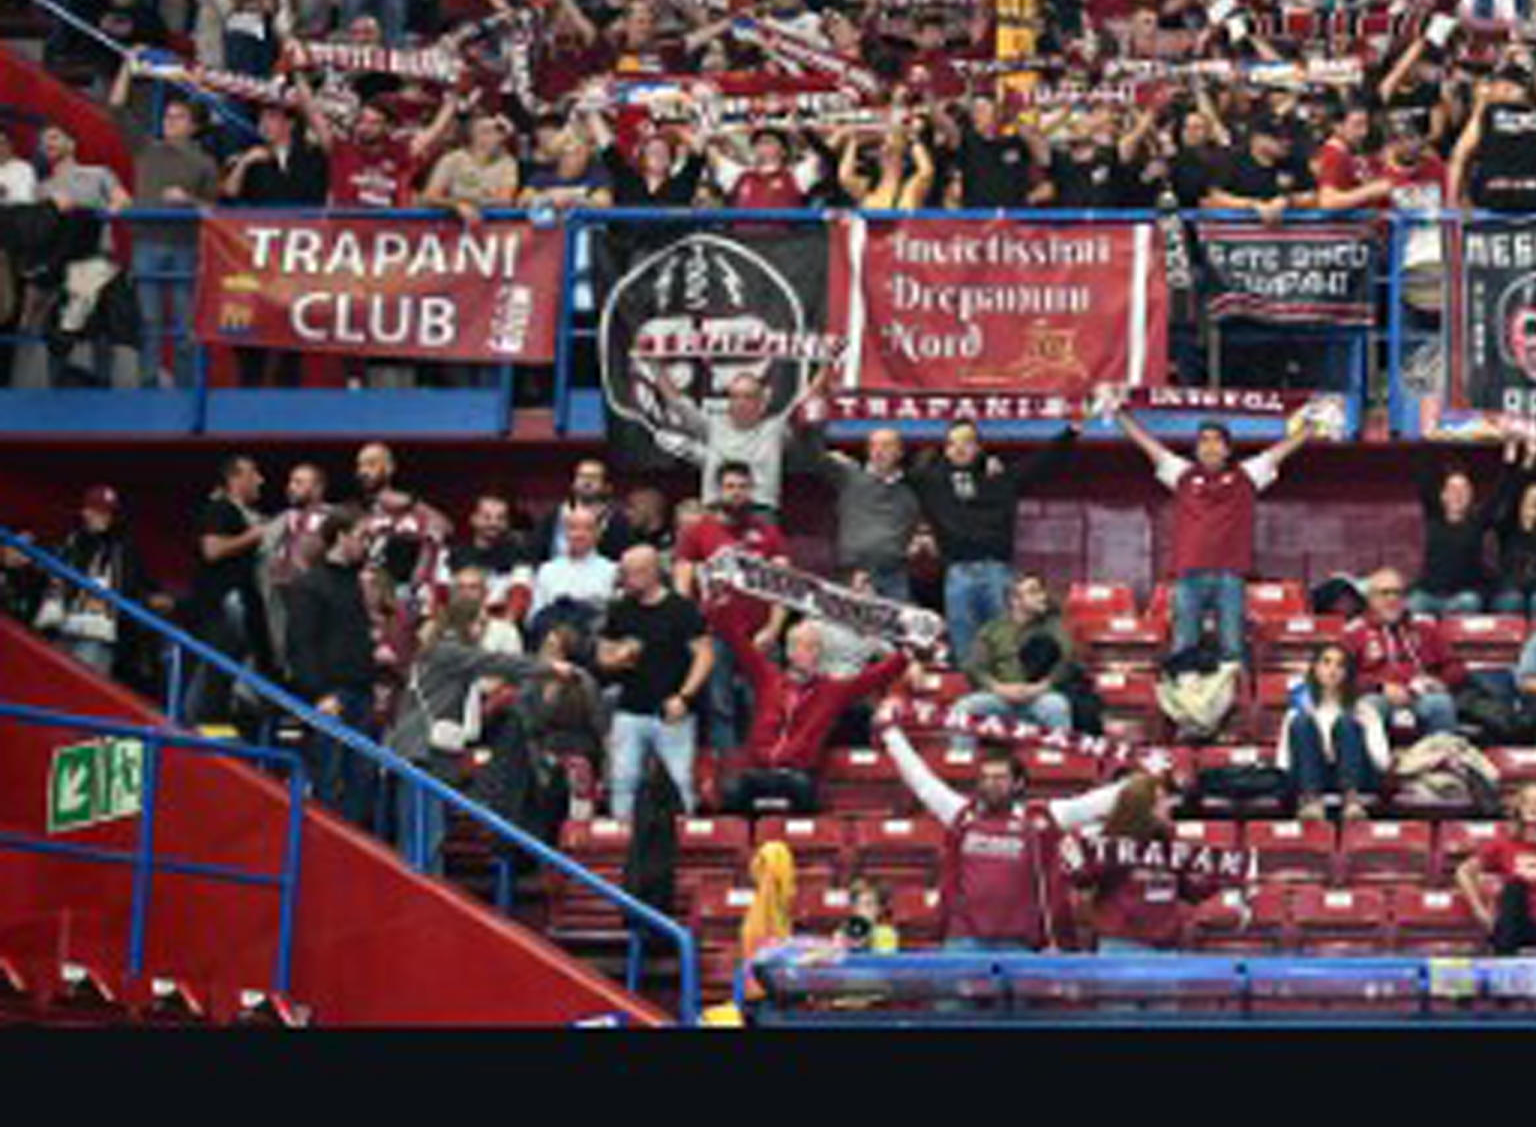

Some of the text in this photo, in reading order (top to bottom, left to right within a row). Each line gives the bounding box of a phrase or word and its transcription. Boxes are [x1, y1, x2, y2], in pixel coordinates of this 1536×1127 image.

[247, 228, 519, 278] TRAPANI
[290, 291, 457, 345] CLUB
[881, 321, 983, 363] Nord
[836, 397, 1029, 419] TRAPANI
[1086, 831, 1259, 880] TRAPANI
